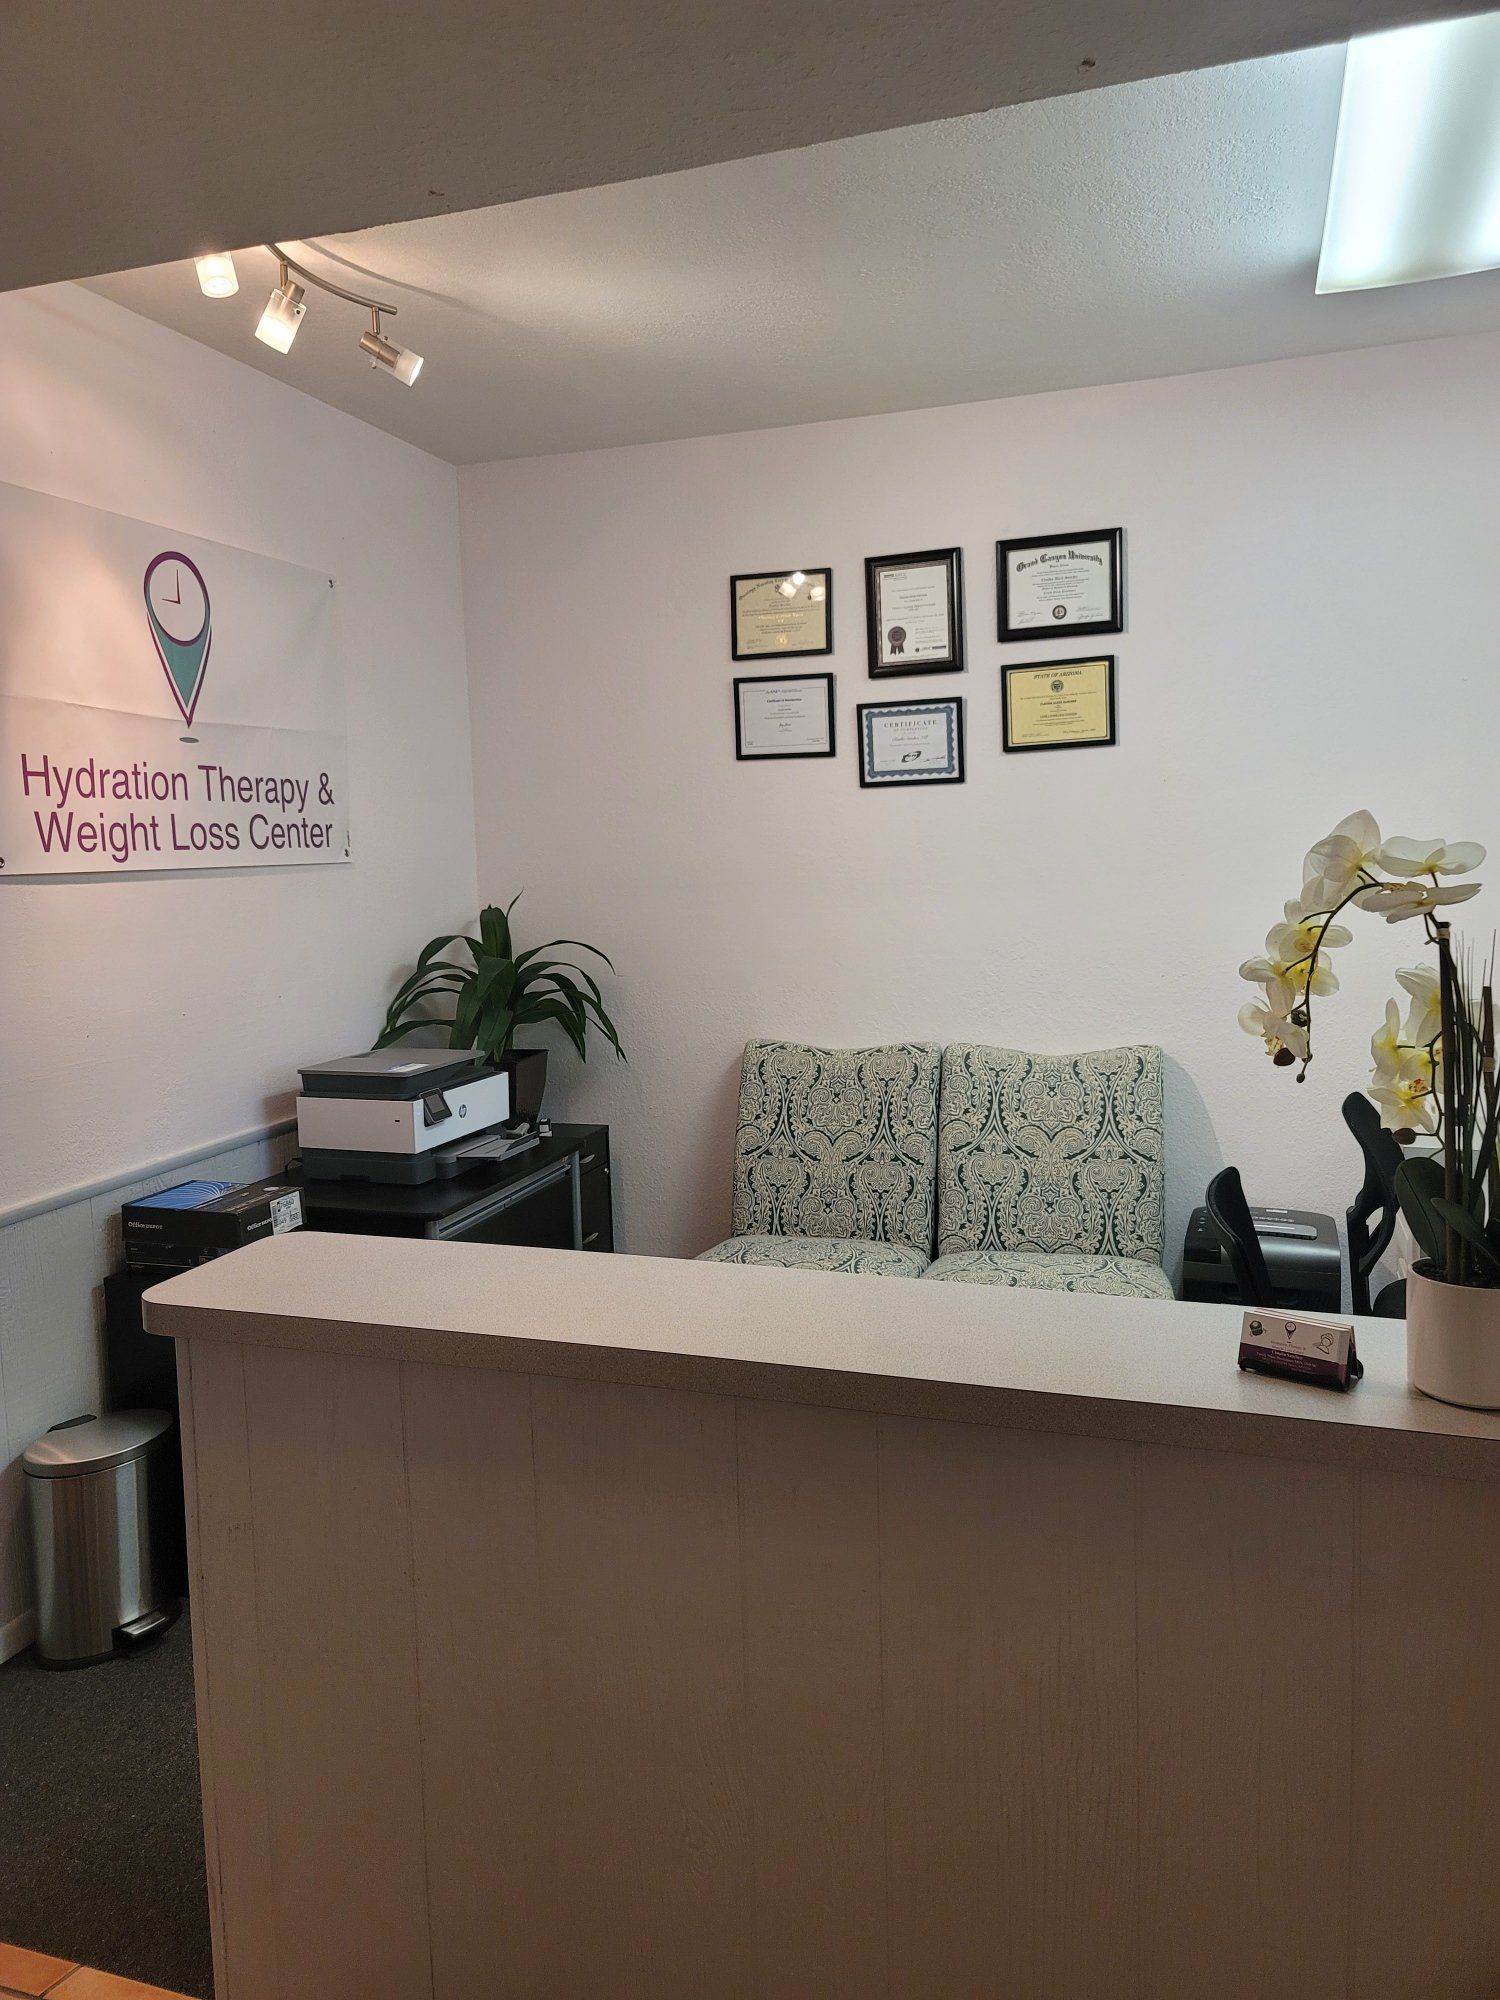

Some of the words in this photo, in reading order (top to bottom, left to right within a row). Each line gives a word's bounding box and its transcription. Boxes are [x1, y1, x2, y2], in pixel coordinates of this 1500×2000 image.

[1016, 558, 1038, 572] Grand
[1039, 553, 1067, 563] Canyon
[1068, 550, 1103, 566] University
[1058, 669, 1083, 678] ARIZONA
[884, 719, 937, 728] CERTIFICATE
[21, 753, 189, 808] Hydration
[198, 765, 310, 813] Therapy
[318, 772, 335, 805] &
[34, 811, 161, 863] Weight
[171, 813, 239, 850] Loss
[249, 813, 333, 850] Center
[247, 1221, 261, 1231] Office
